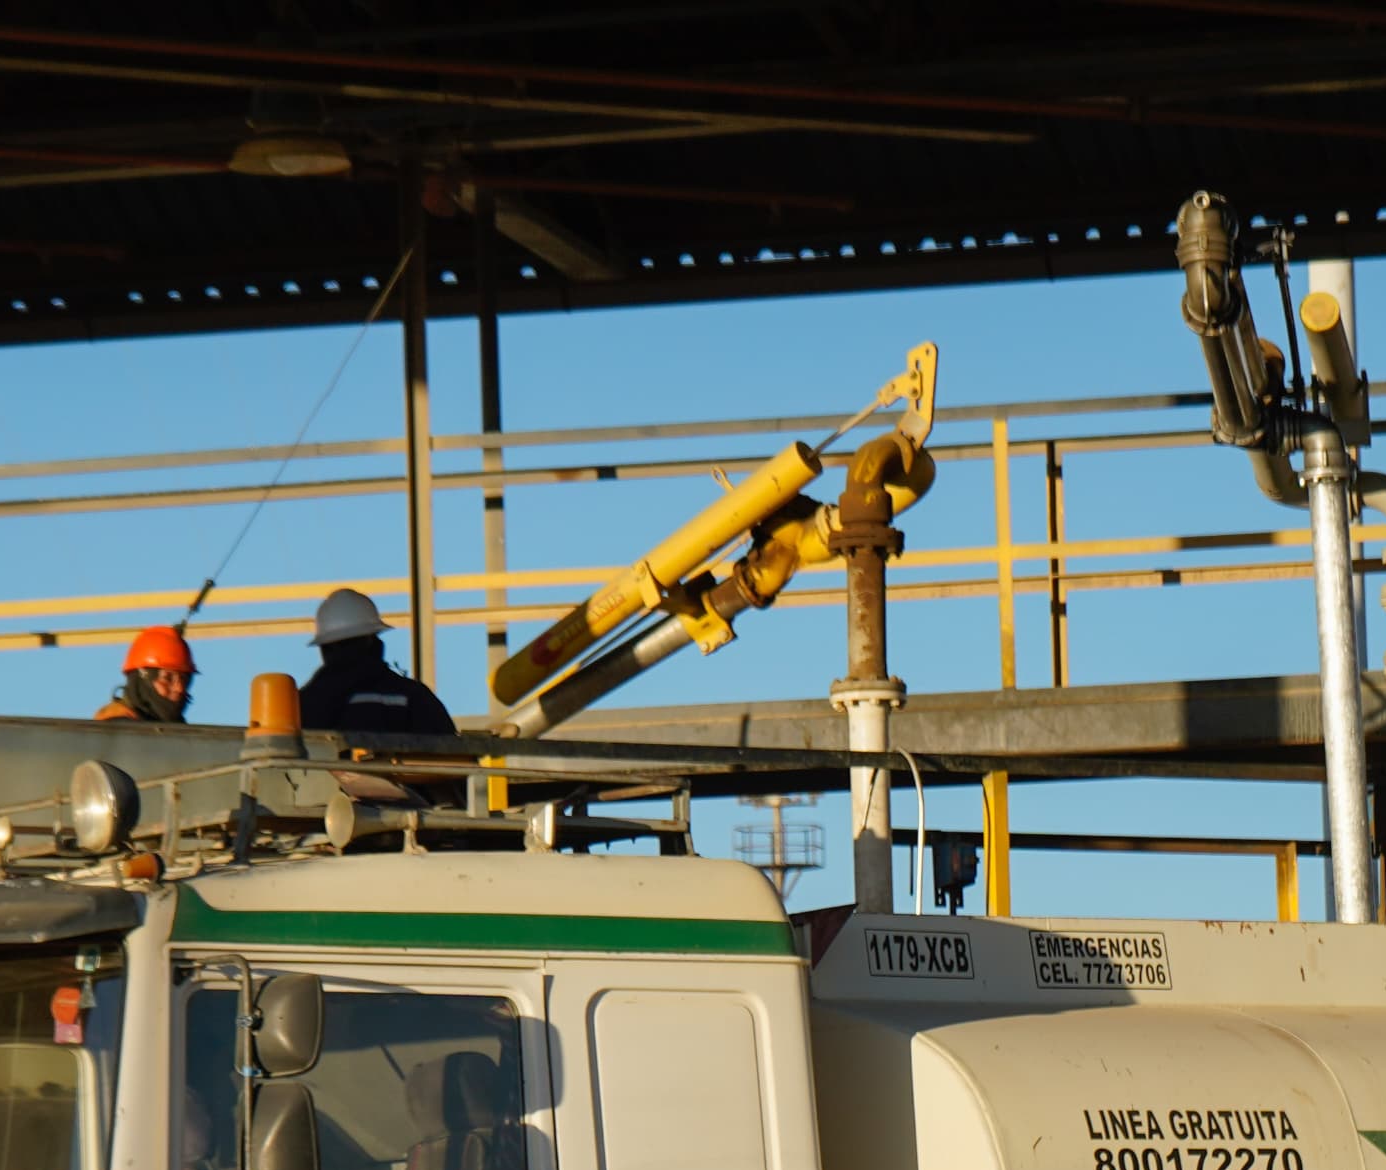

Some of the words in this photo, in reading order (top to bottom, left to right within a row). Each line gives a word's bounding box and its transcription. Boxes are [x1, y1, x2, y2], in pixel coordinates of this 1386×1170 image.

[869, 933, 970, 974] 1179-XCB
[1035, 934, 1163, 959] EMERGENCIAS
[1039, 961, 1079, 985] CEL.
[1081, 961, 1168, 986] 77273706
[1083, 1109, 1165, 1141] LINEA
[1168, 1109, 1299, 1141] GRATUITA
